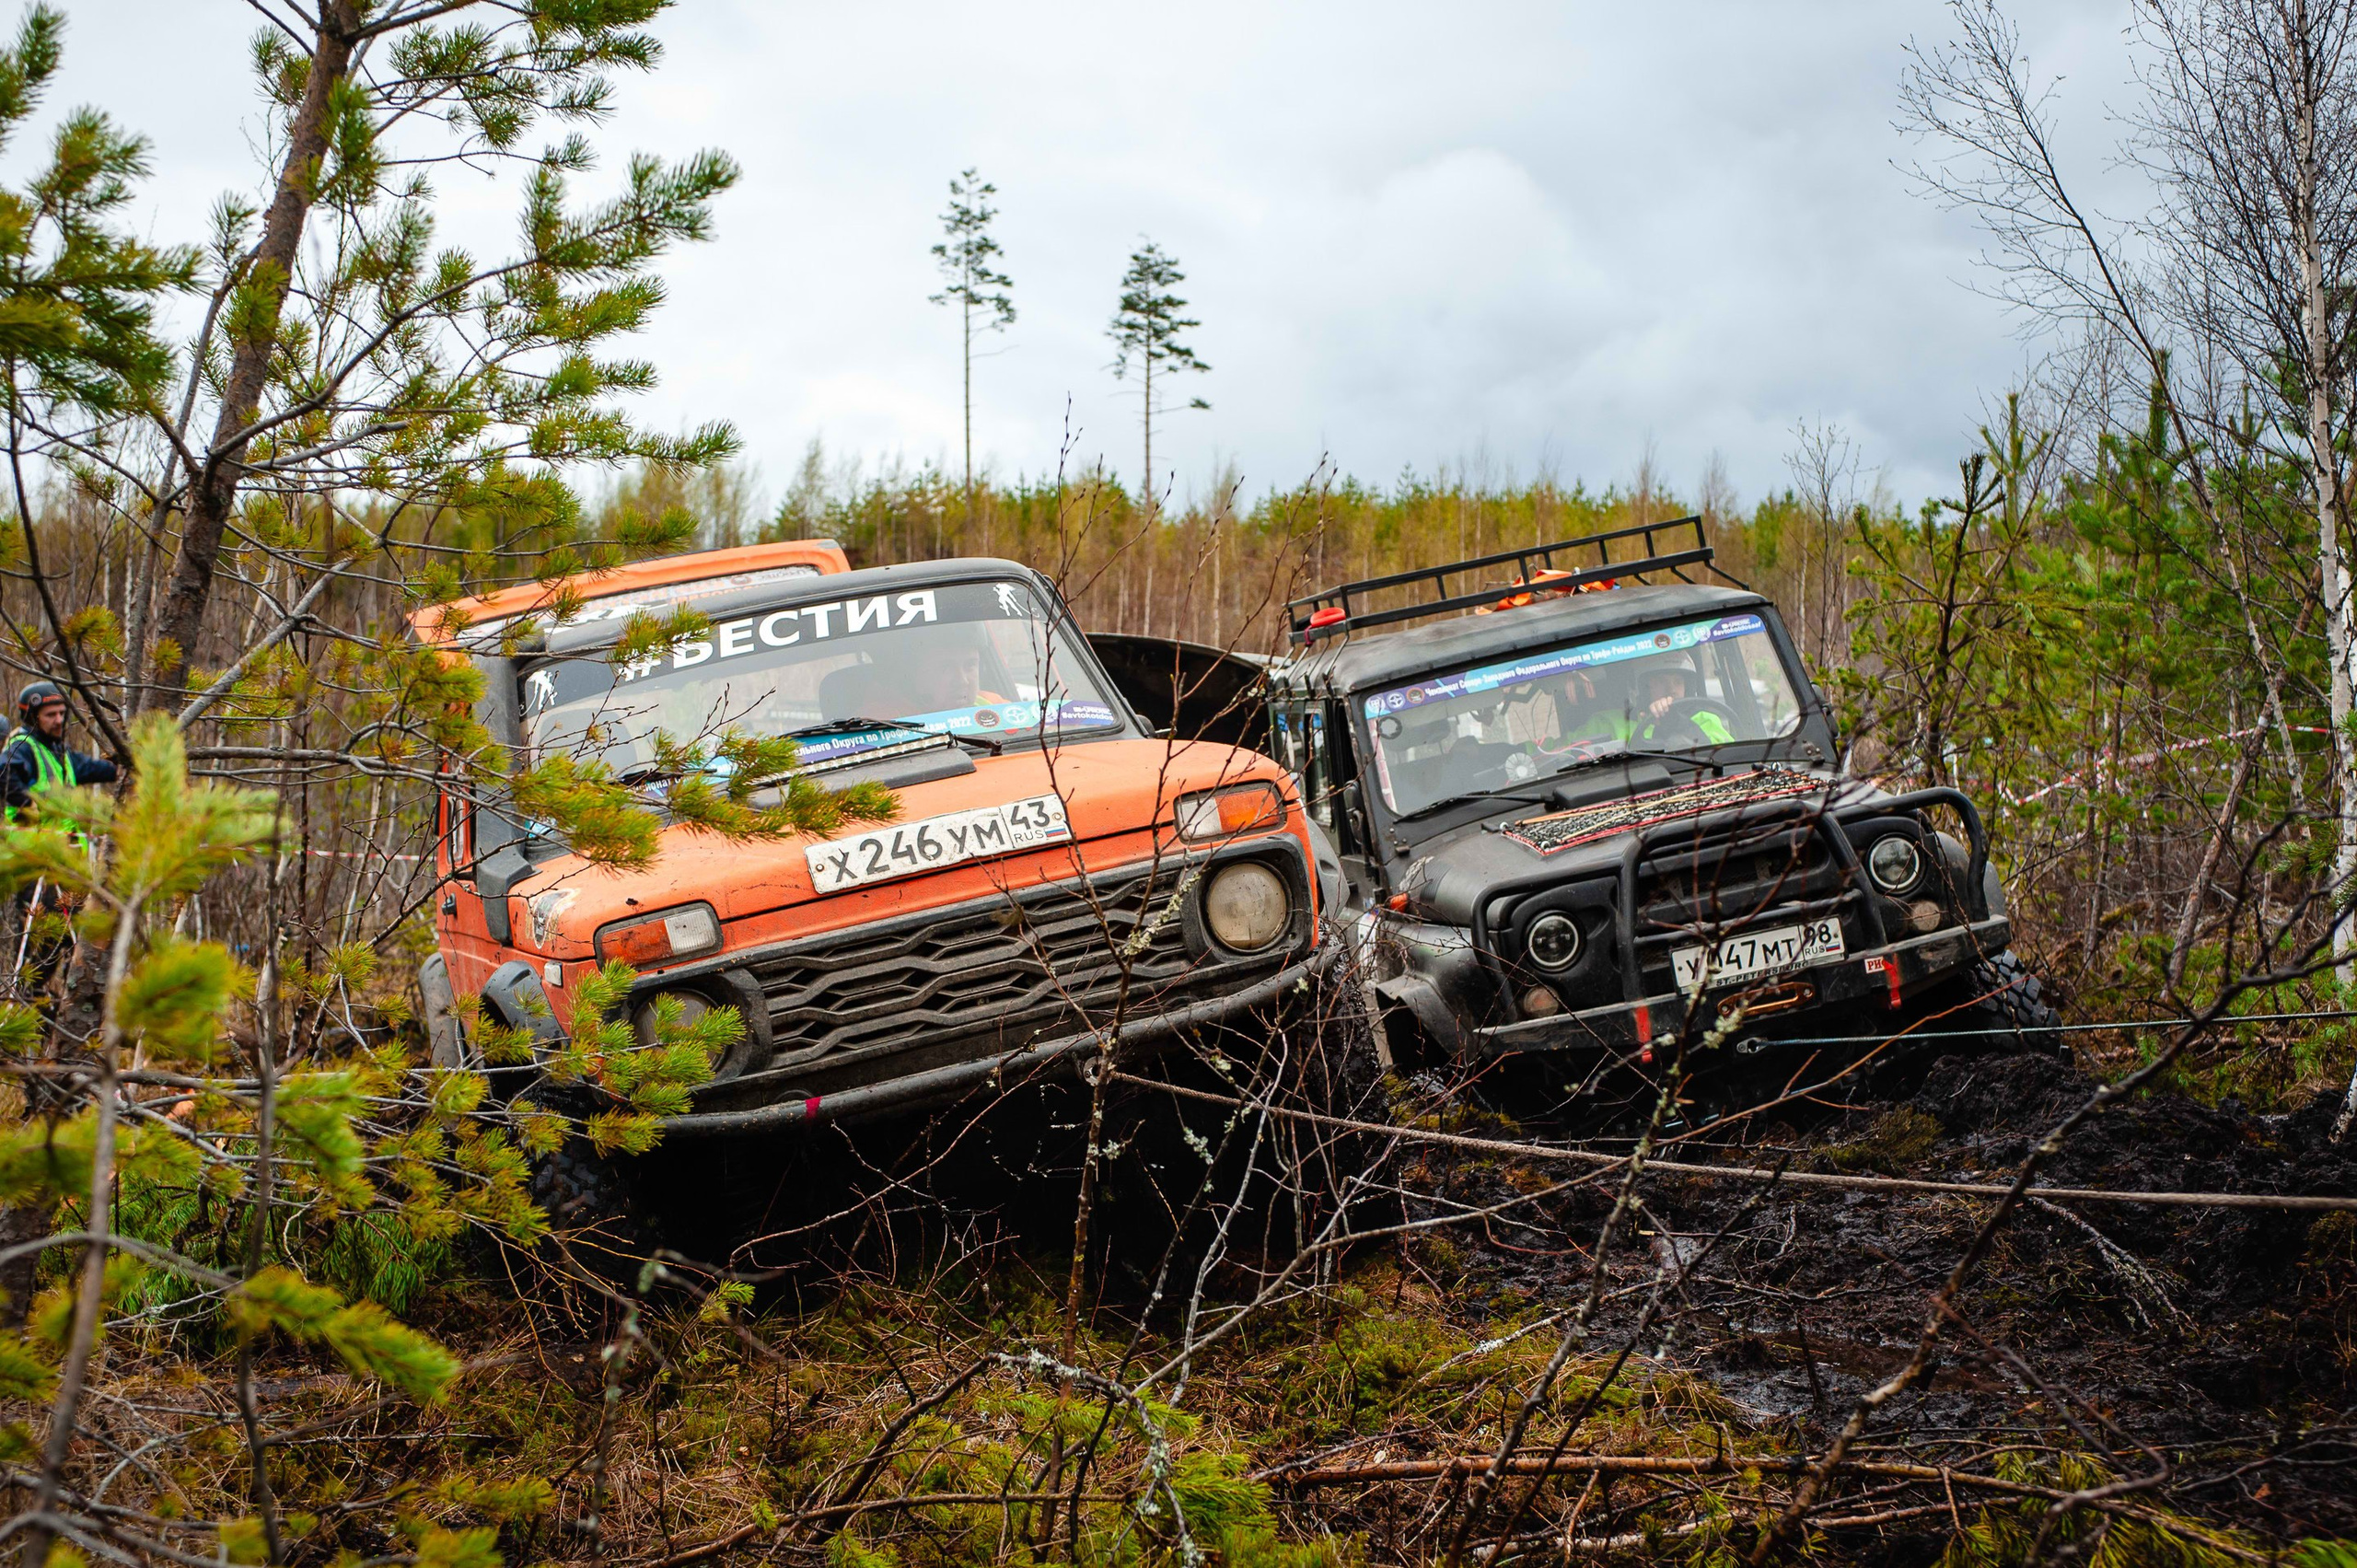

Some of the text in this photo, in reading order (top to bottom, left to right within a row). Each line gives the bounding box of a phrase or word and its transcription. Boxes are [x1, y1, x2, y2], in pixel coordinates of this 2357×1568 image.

[1424, 682, 1459, 697] Чемпионат
[1458, 668, 1515, 689] Северо-Западного
[1515, 660, 1561, 675] Федерального
[1560, 655, 1583, 667] Округа
[1583, 653, 1591, 661] по
[1636, 639, 1652, 649] 2022
[831, 735, 865, 749] Округа
[866, 733, 878, 743] по
[947, 716, 972, 730] 2022
[829, 800, 1051, 883] Х246УМ 43
[1013, 830, 1044, 843] RUS
[1804, 923, 1831, 947] 98
[1805, 944, 1826, 956] RUS
[1715, 960, 1809, 987] ST.-PETERSBURG
[1867, 958, 1885, 971] РИ
